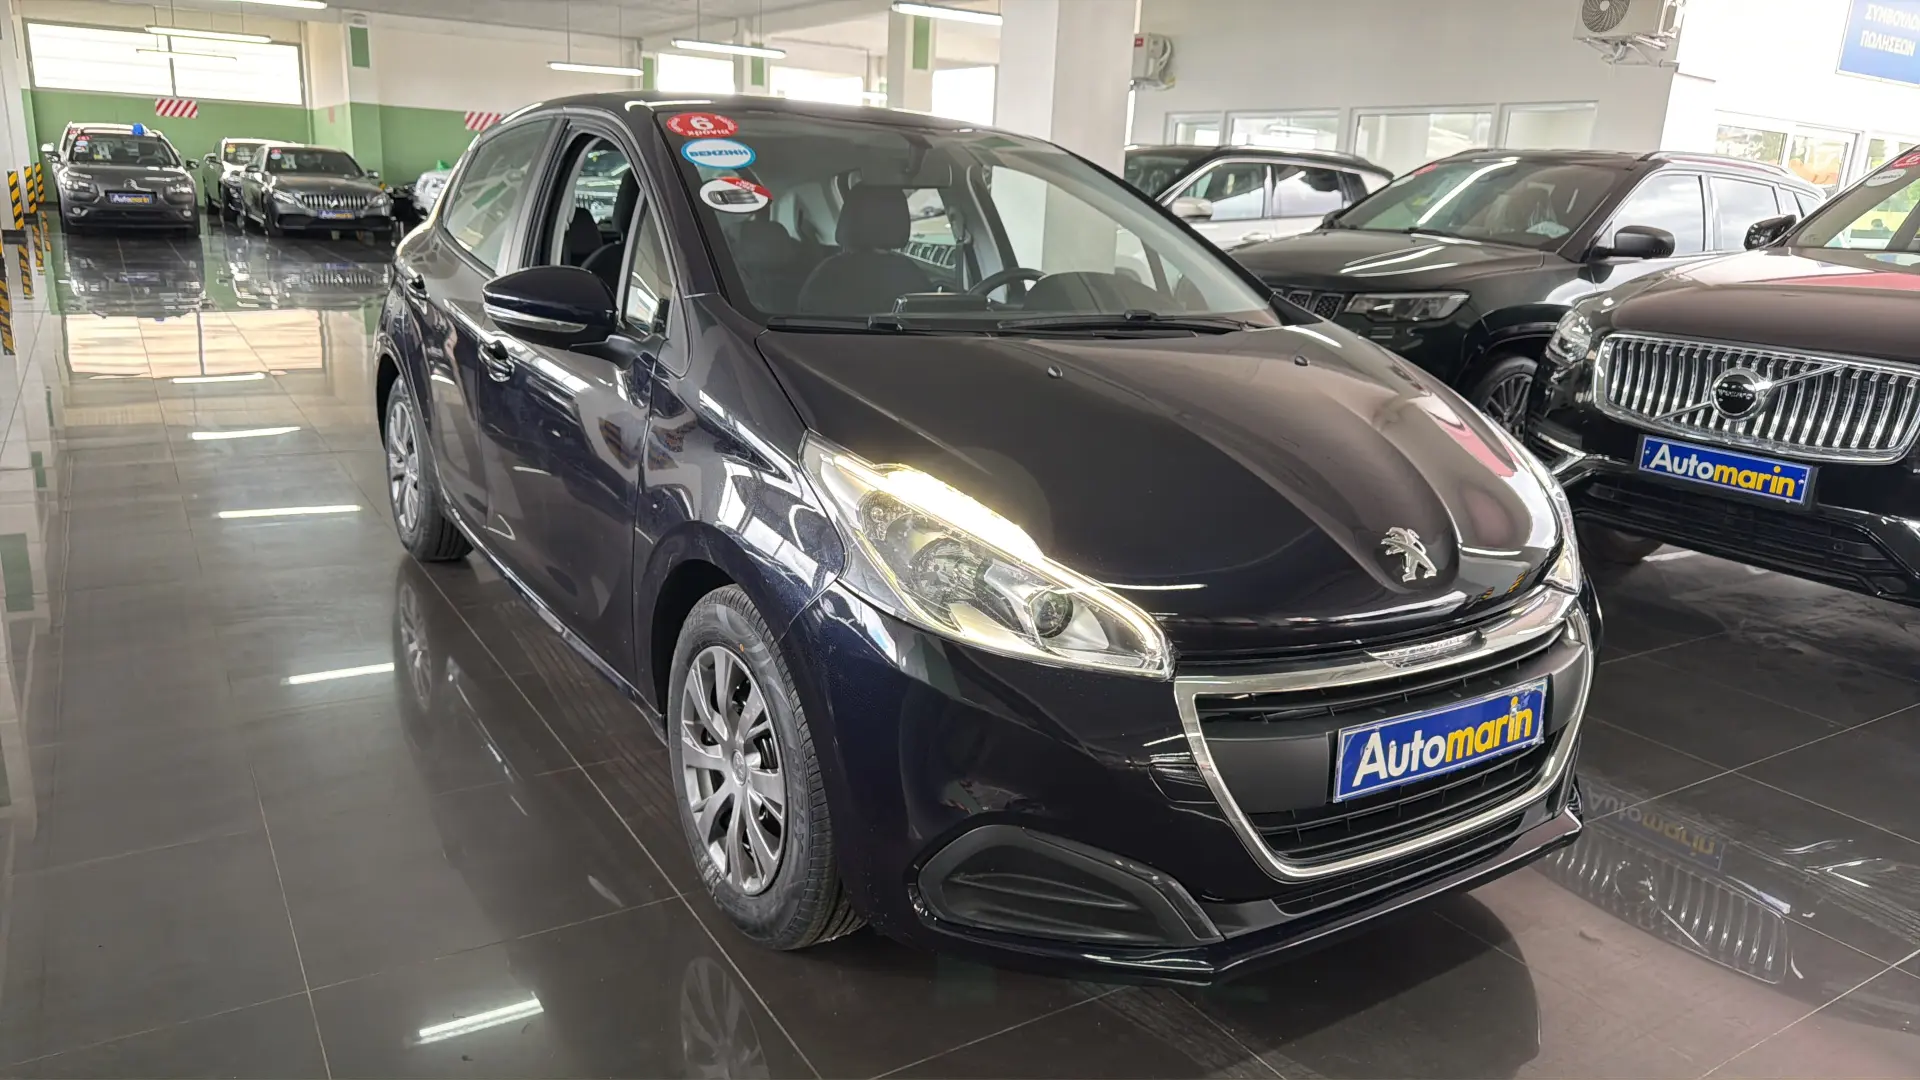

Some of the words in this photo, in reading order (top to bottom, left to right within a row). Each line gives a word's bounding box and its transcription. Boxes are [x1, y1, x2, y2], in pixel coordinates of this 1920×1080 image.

[690, 116, 714, 130] 6
[1650, 444, 1796, 497] Automarin
[1352, 696, 1533, 787] Automarin
